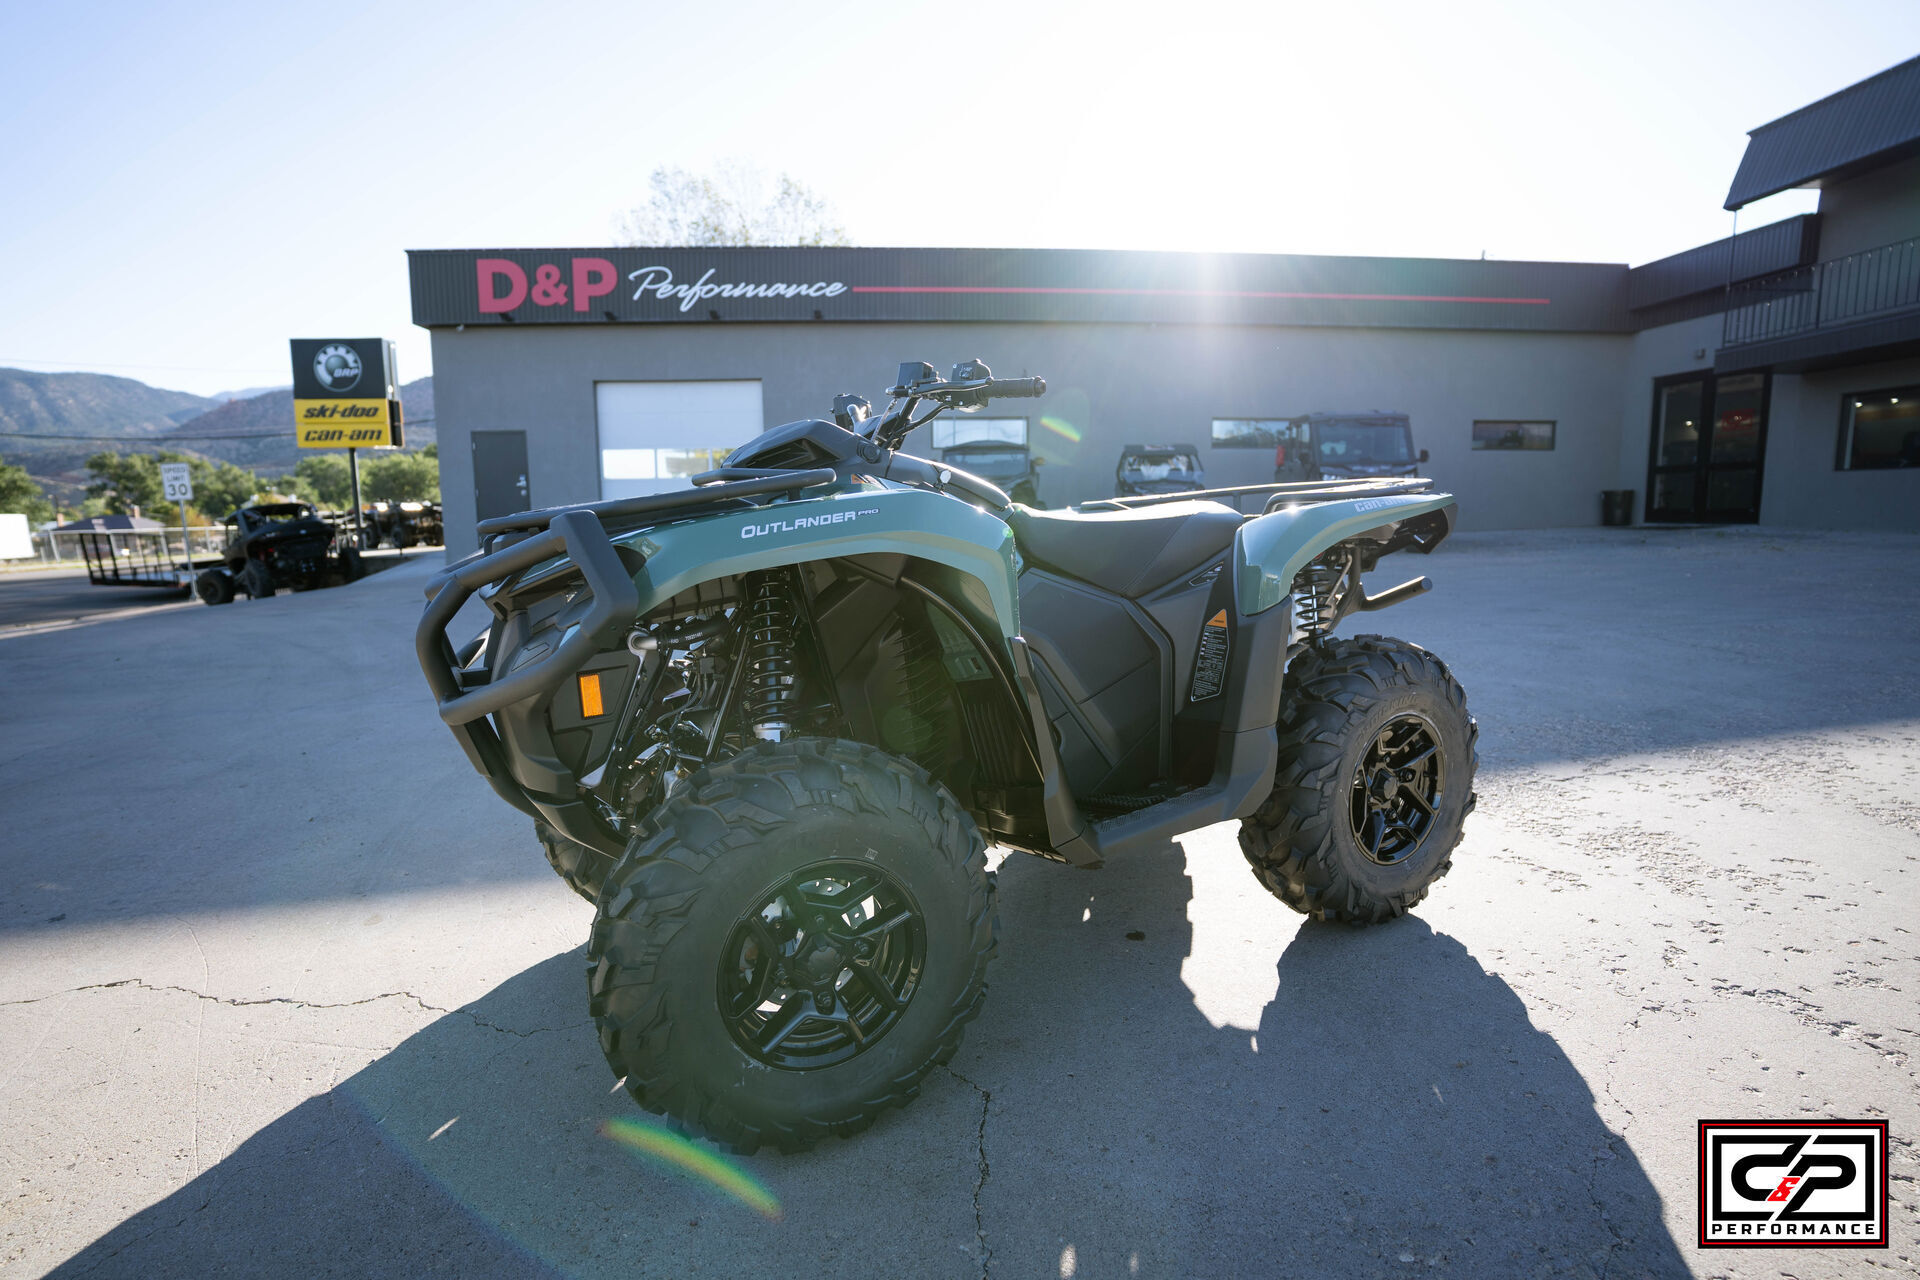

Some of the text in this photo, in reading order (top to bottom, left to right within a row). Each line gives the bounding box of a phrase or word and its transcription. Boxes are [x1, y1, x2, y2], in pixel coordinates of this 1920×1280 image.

[476, 257, 848, 314] D&P Performance
[333, 368, 360, 378] BRP
[303, 405, 379, 418] ski-doo
[304, 429, 382, 442] can-am
[168, 483, 188, 497] 30
[741, 508, 880, 539] OUTLANDER PRO
